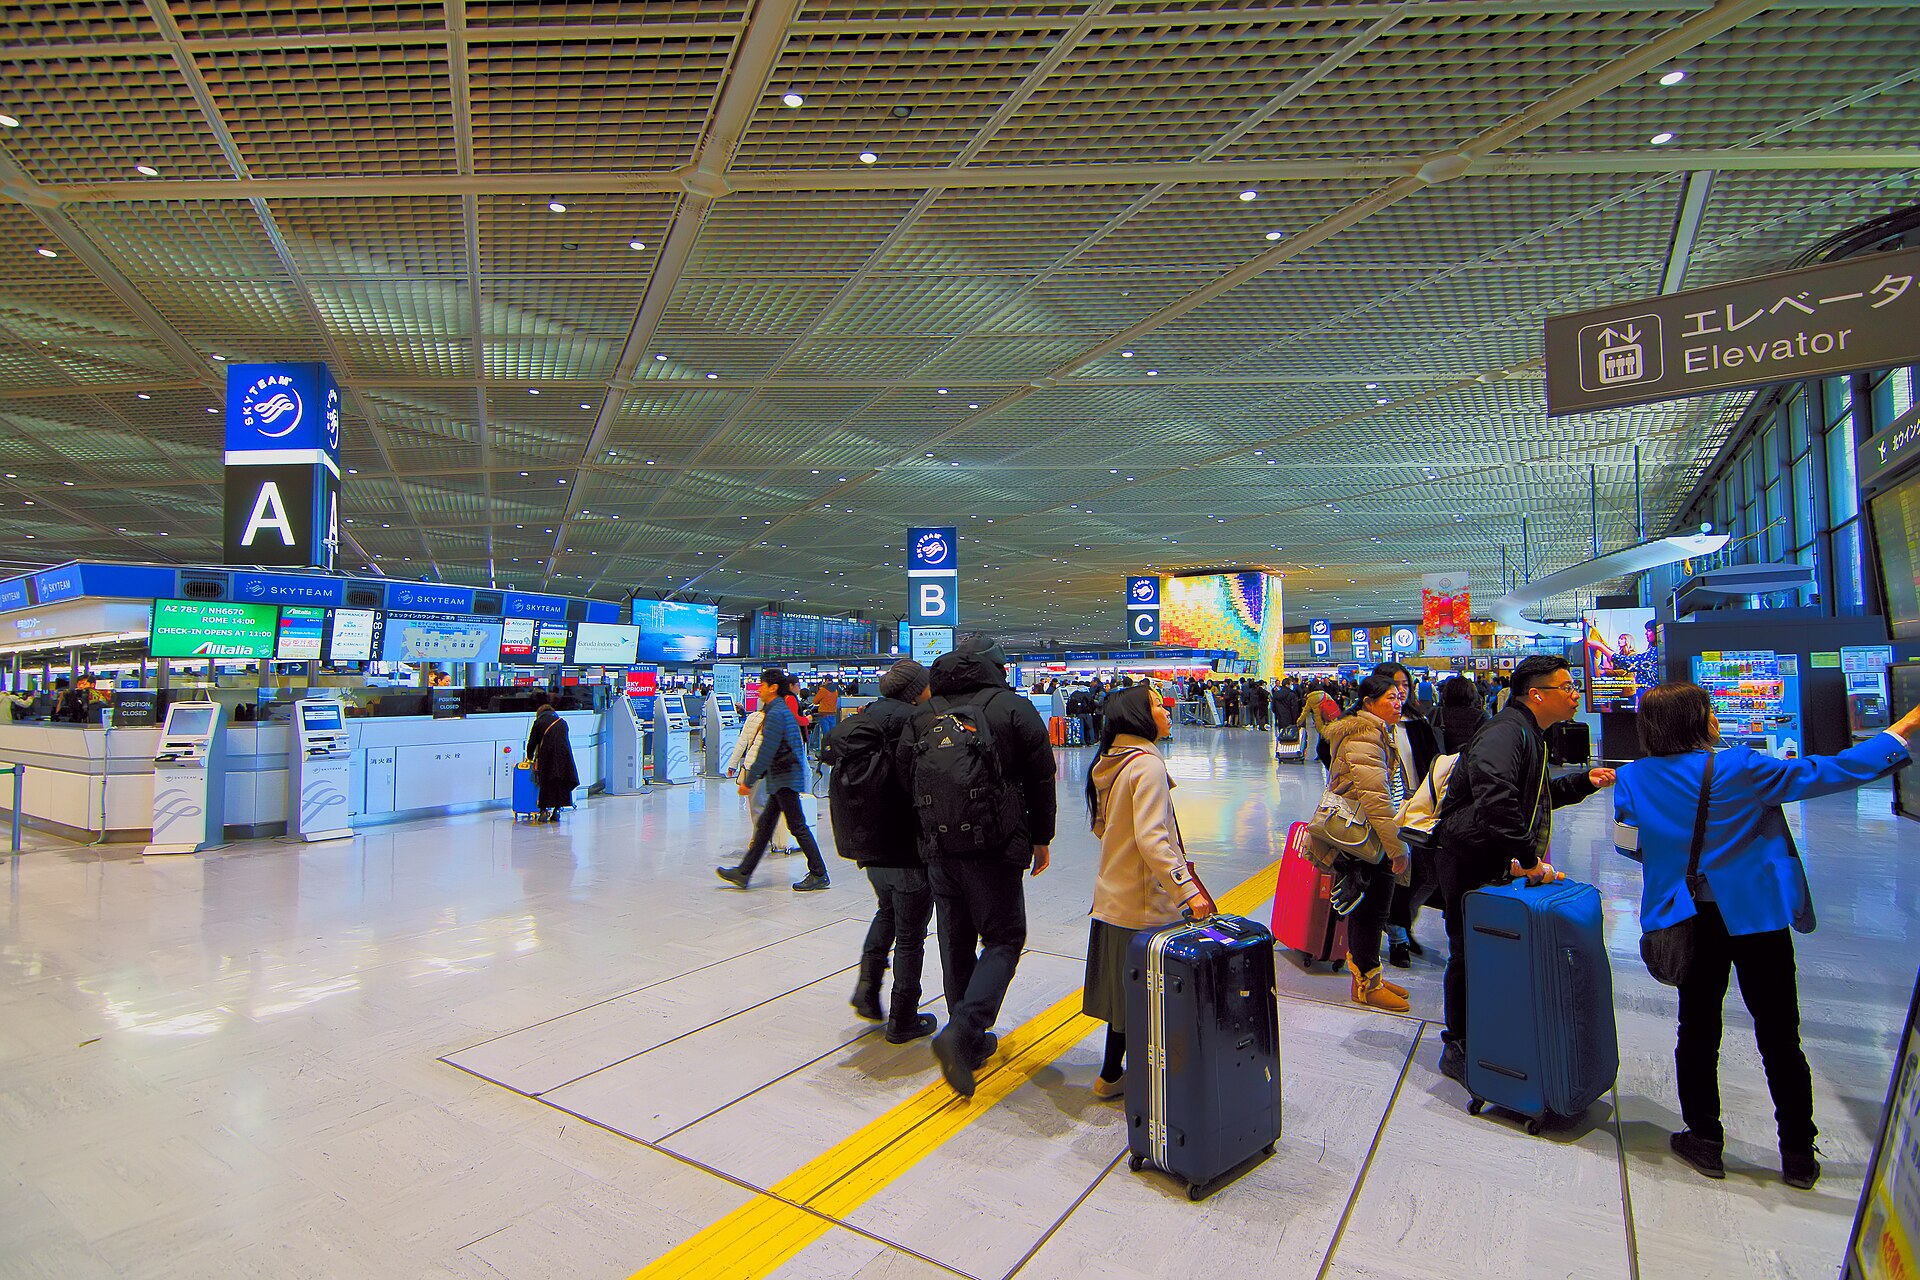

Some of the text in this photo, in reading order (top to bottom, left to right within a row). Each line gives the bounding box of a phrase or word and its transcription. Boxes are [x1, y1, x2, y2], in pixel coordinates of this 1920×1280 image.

[1681, 274, 1920, 338] エレベータ
[1684, 328, 1852, 374] Elevator
[243, 375, 292, 426] SKYTEAM
[240, 482, 296, 546] A
[917, 533, 942, 558] SKYTEAM
[48, 580, 70, 592] SKYTEAM
[271, 587, 333, 597] SKYTEAM
[2, 592, 20, 602] SKYTEAM
[417, 596, 465, 605] SKYTEAM
[920, 584, 946, 616] B
[526, 604, 561, 612] SKYTEAM
[1135, 614, 1154, 636] C
[192, 641, 253, 655] Alitalia
[1314, 641, 1327, 654] D
[1356, 647, 1365, 658] E
[1386, 651, 1393, 661] F
